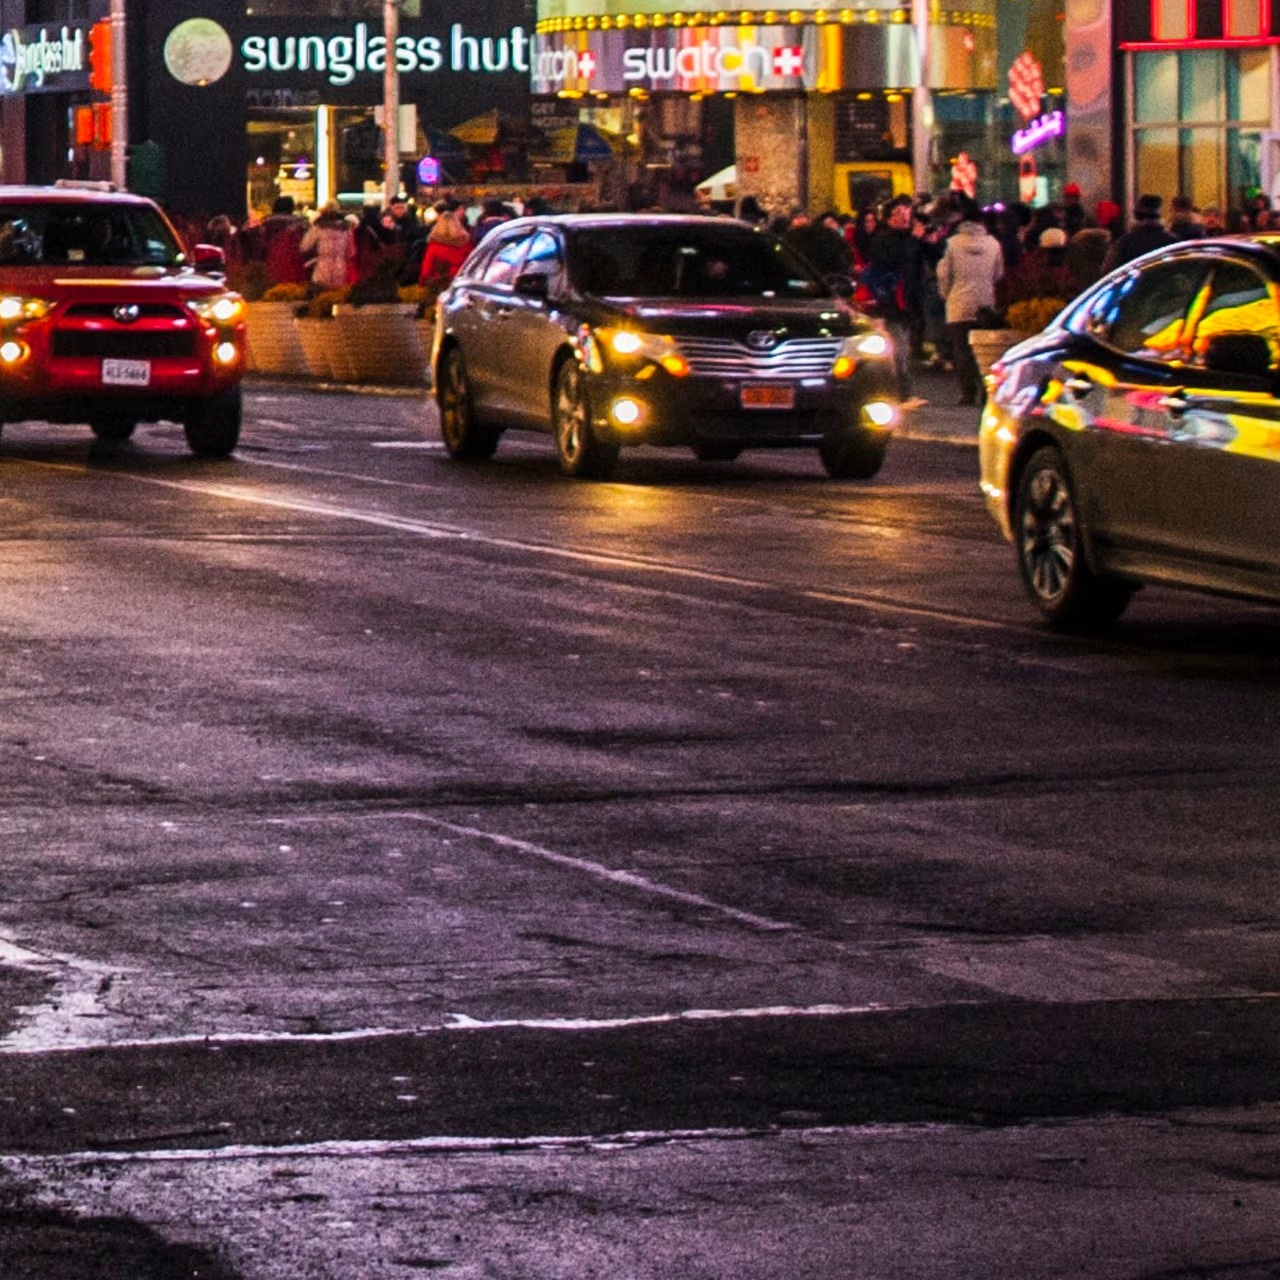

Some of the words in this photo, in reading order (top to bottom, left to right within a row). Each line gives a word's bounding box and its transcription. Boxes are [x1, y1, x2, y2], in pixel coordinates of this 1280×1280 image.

[241, 22, 442, 86] sunglass
[450, 22, 530, 72] hut
[623, 39, 771, 81] swatch
